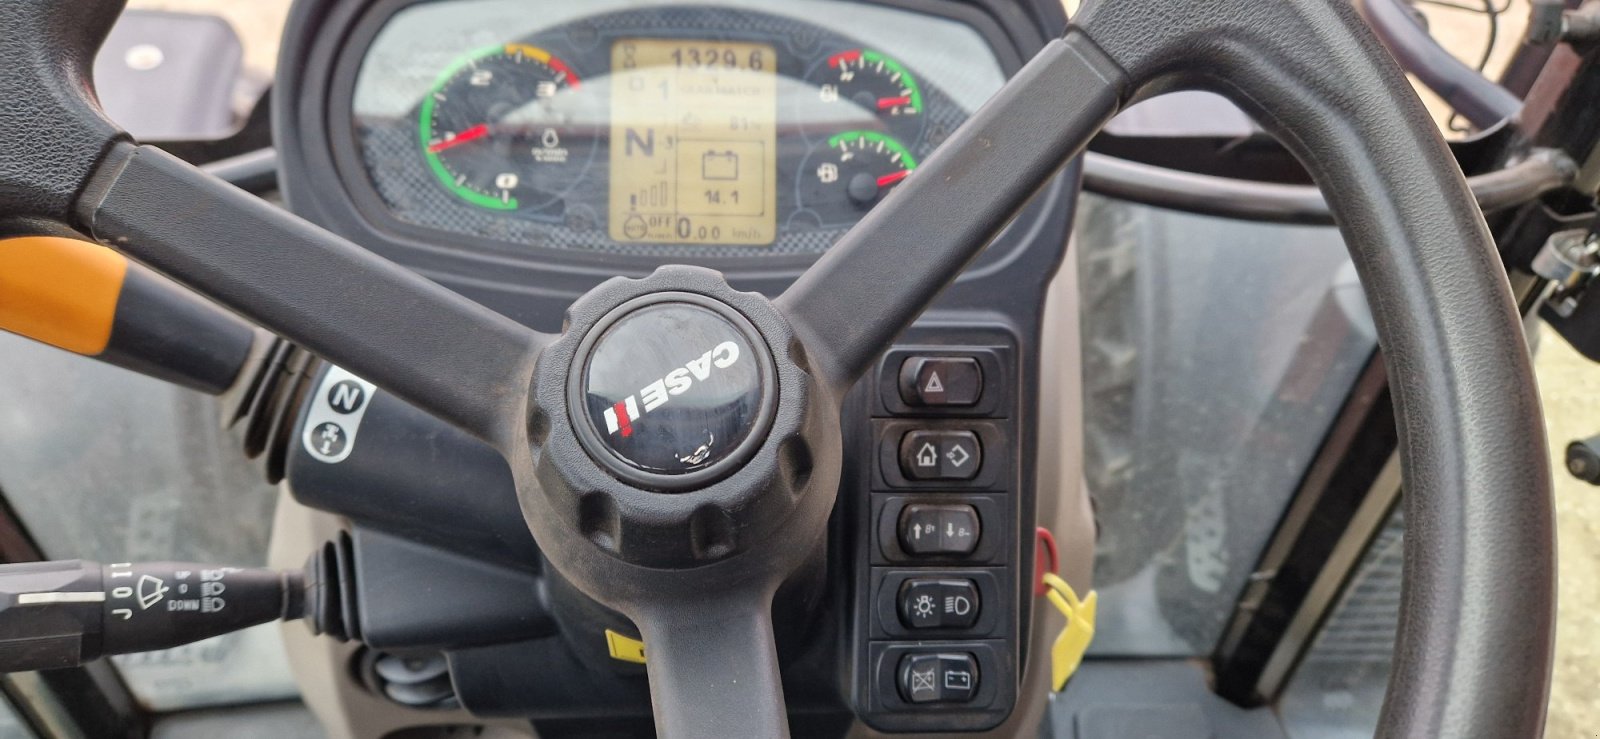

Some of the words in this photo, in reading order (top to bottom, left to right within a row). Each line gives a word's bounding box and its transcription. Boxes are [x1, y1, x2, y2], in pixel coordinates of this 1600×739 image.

[672, 49, 763, 70] 1329.6
[470, 70, 493, 86] 2
[625, 128, 654, 157] N
[704, 190, 739, 204] 14.1
[640, 341, 740, 413] CASE
[332, 383, 360, 410] N
[167, 599, 200, 611] DOWN
